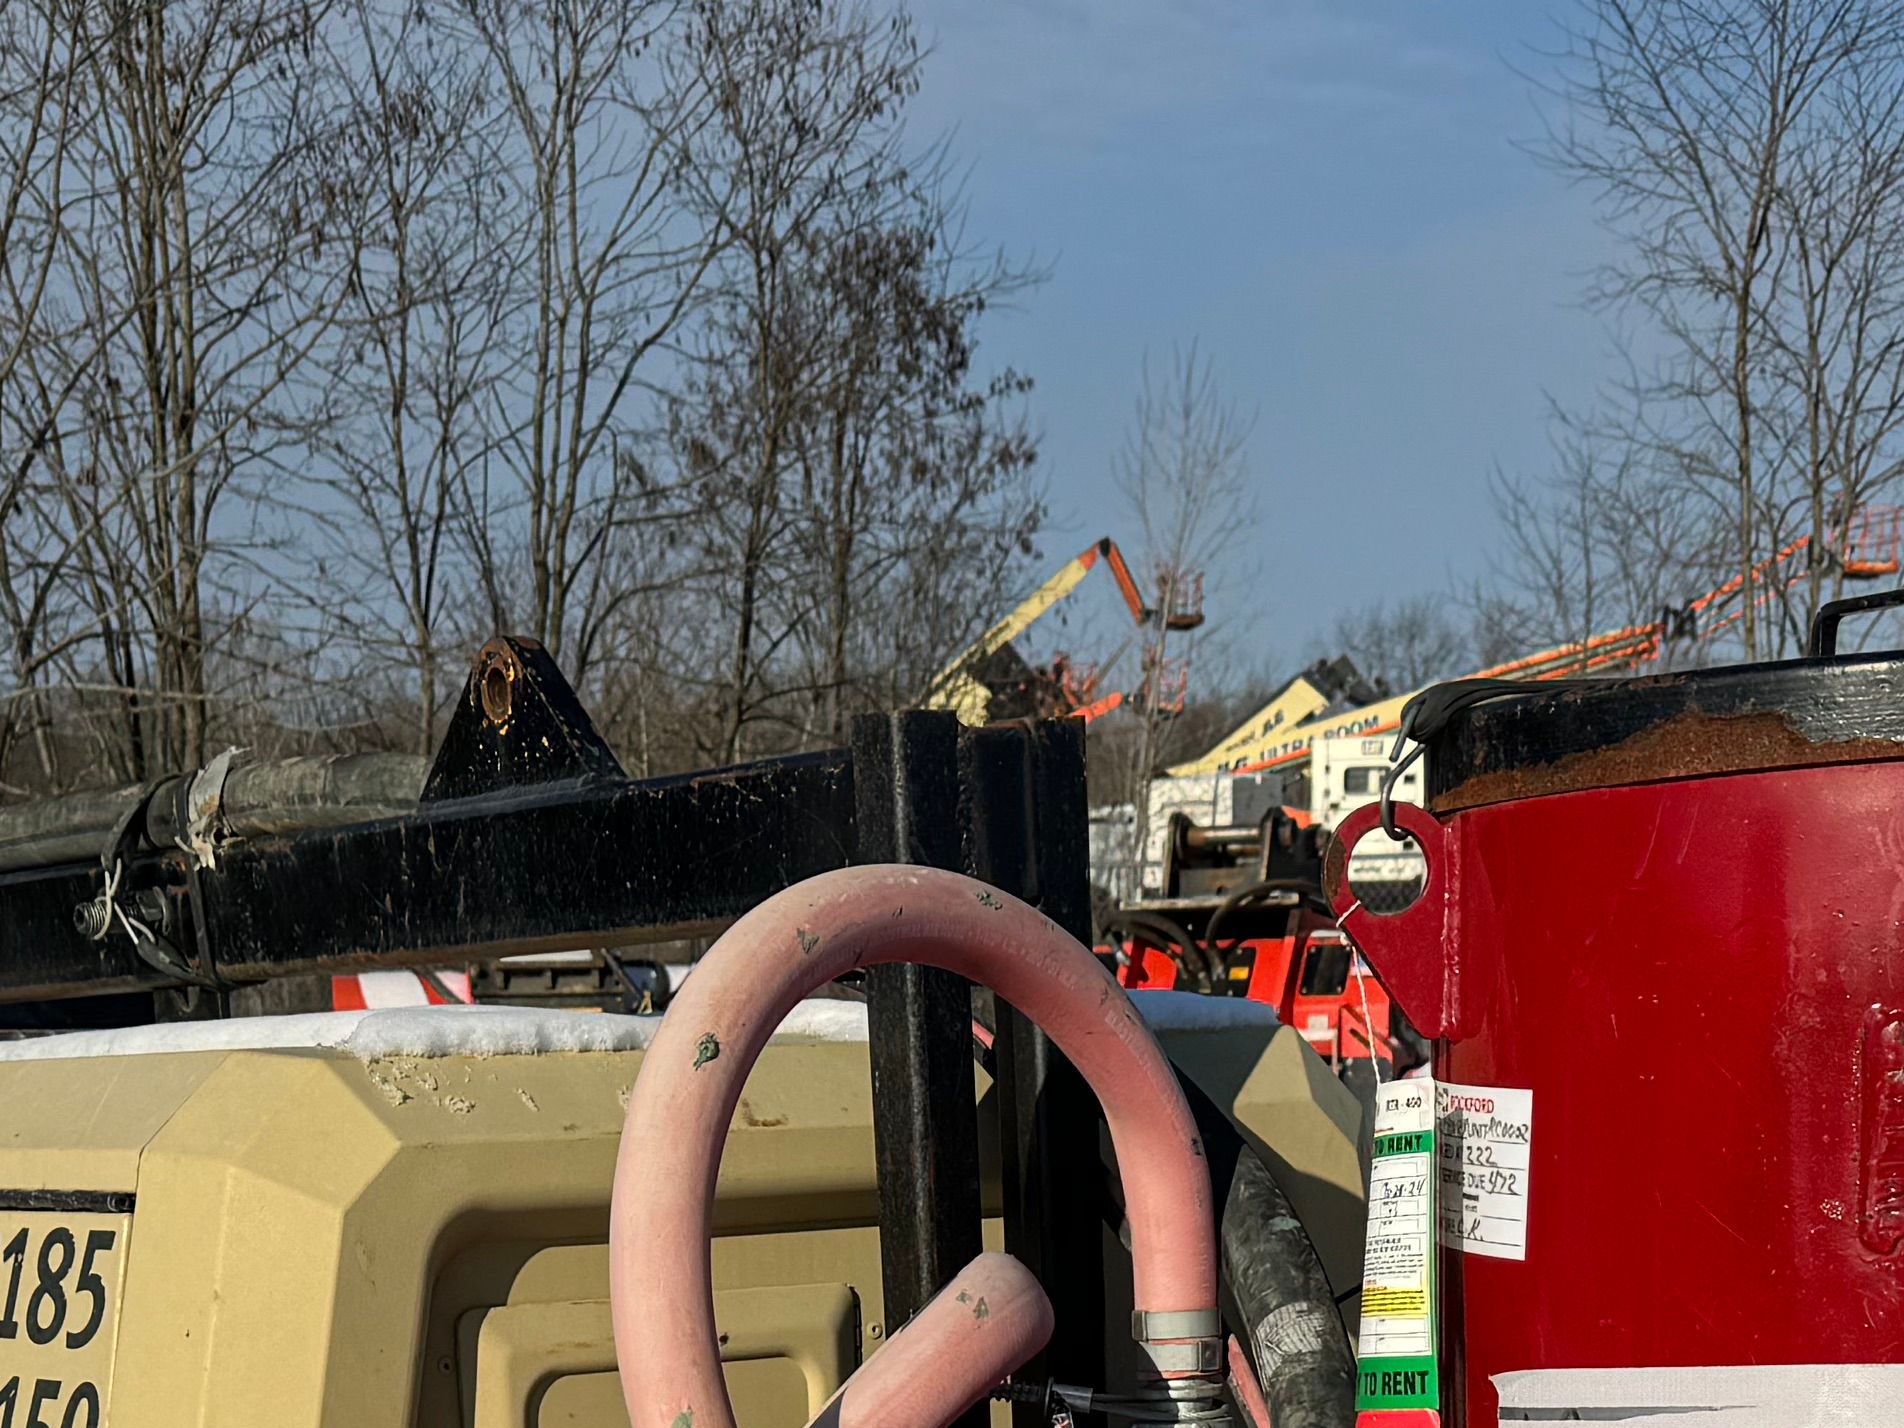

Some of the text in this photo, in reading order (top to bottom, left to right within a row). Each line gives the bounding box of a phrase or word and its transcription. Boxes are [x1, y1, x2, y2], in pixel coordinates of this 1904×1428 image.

[1387, 1134, 1423, 1153] RENT
[1364, 1370, 1430, 1397] TO RENT
